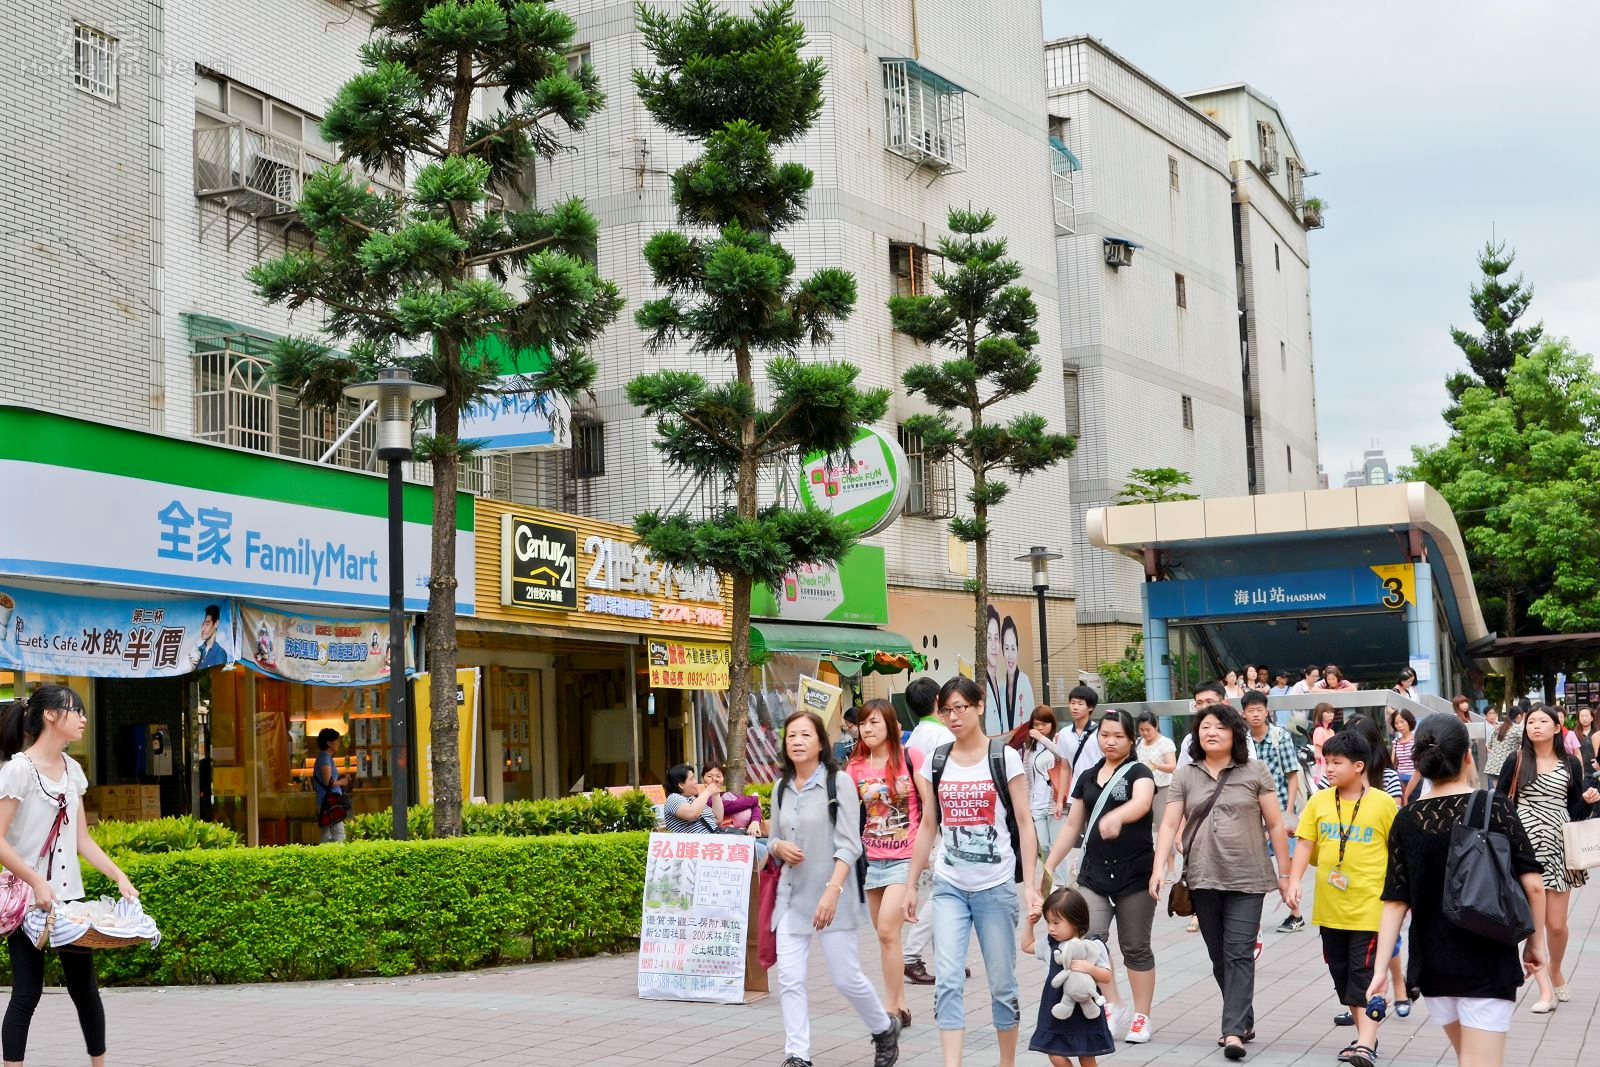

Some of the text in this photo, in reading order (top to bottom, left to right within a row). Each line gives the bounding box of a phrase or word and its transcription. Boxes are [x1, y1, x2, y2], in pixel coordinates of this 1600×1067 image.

[841, 467, 882, 484] Check FUN
[157, 500, 378, 586] 全家 FamilyMart
[514, 524, 575, 589] Century 21
[1234, 586, 1327, 606] 海山站 HAISHAN
[1382, 577, 1405, 609] 3
[131, 608, 166, 625] 第二杯
[53, 635, 78, 652] Café
[938, 782, 996, 792] CAR PARK
[943, 790, 986, 800] PERMIT
[943, 799, 990, 808] HOLDERS
[950, 808, 980, 817] ONLY
